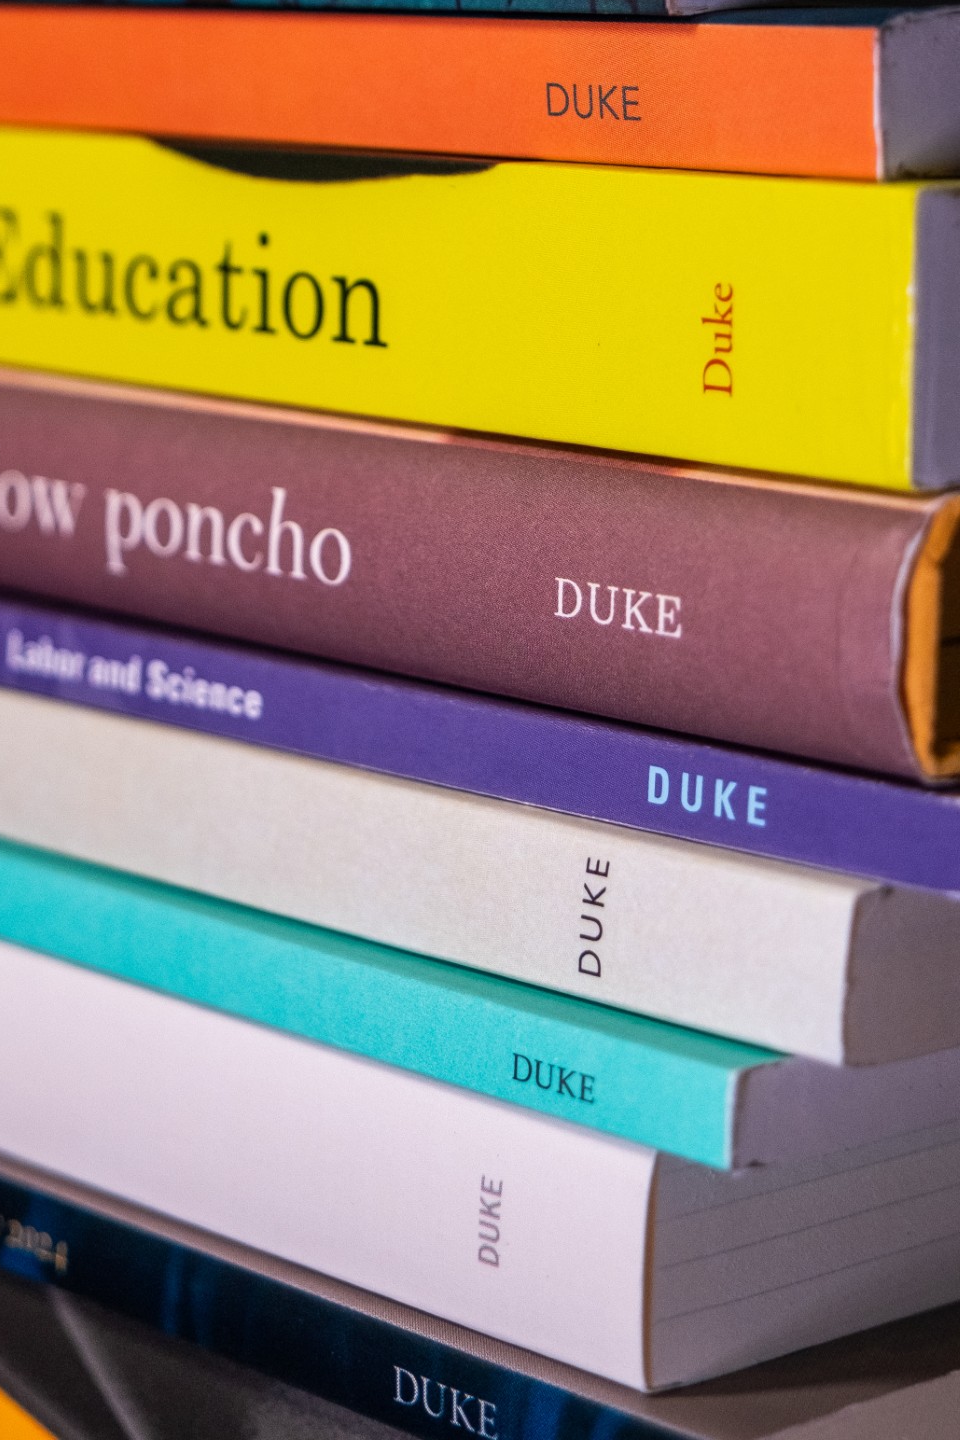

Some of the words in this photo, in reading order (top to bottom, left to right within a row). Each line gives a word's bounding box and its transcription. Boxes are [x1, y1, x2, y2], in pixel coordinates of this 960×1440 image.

[545, 81, 643, 123] DUKE
[702, 280, 735, 398] Duke
[103, 487, 352, 586] poncho
[553, 576, 683, 640] DUKE
[6, 630, 85, 685] Labor
[88, 646, 142, 696] and
[146, 658, 263, 720] Science
[646, 765, 769, 828] DUKE
[577, 856, 611, 978] DUKE
[511, 1053, 596, 1104] DUKE
[477, 1174, 505, 1268] DUKE
[393, 1365, 499, 1440] DUKE
